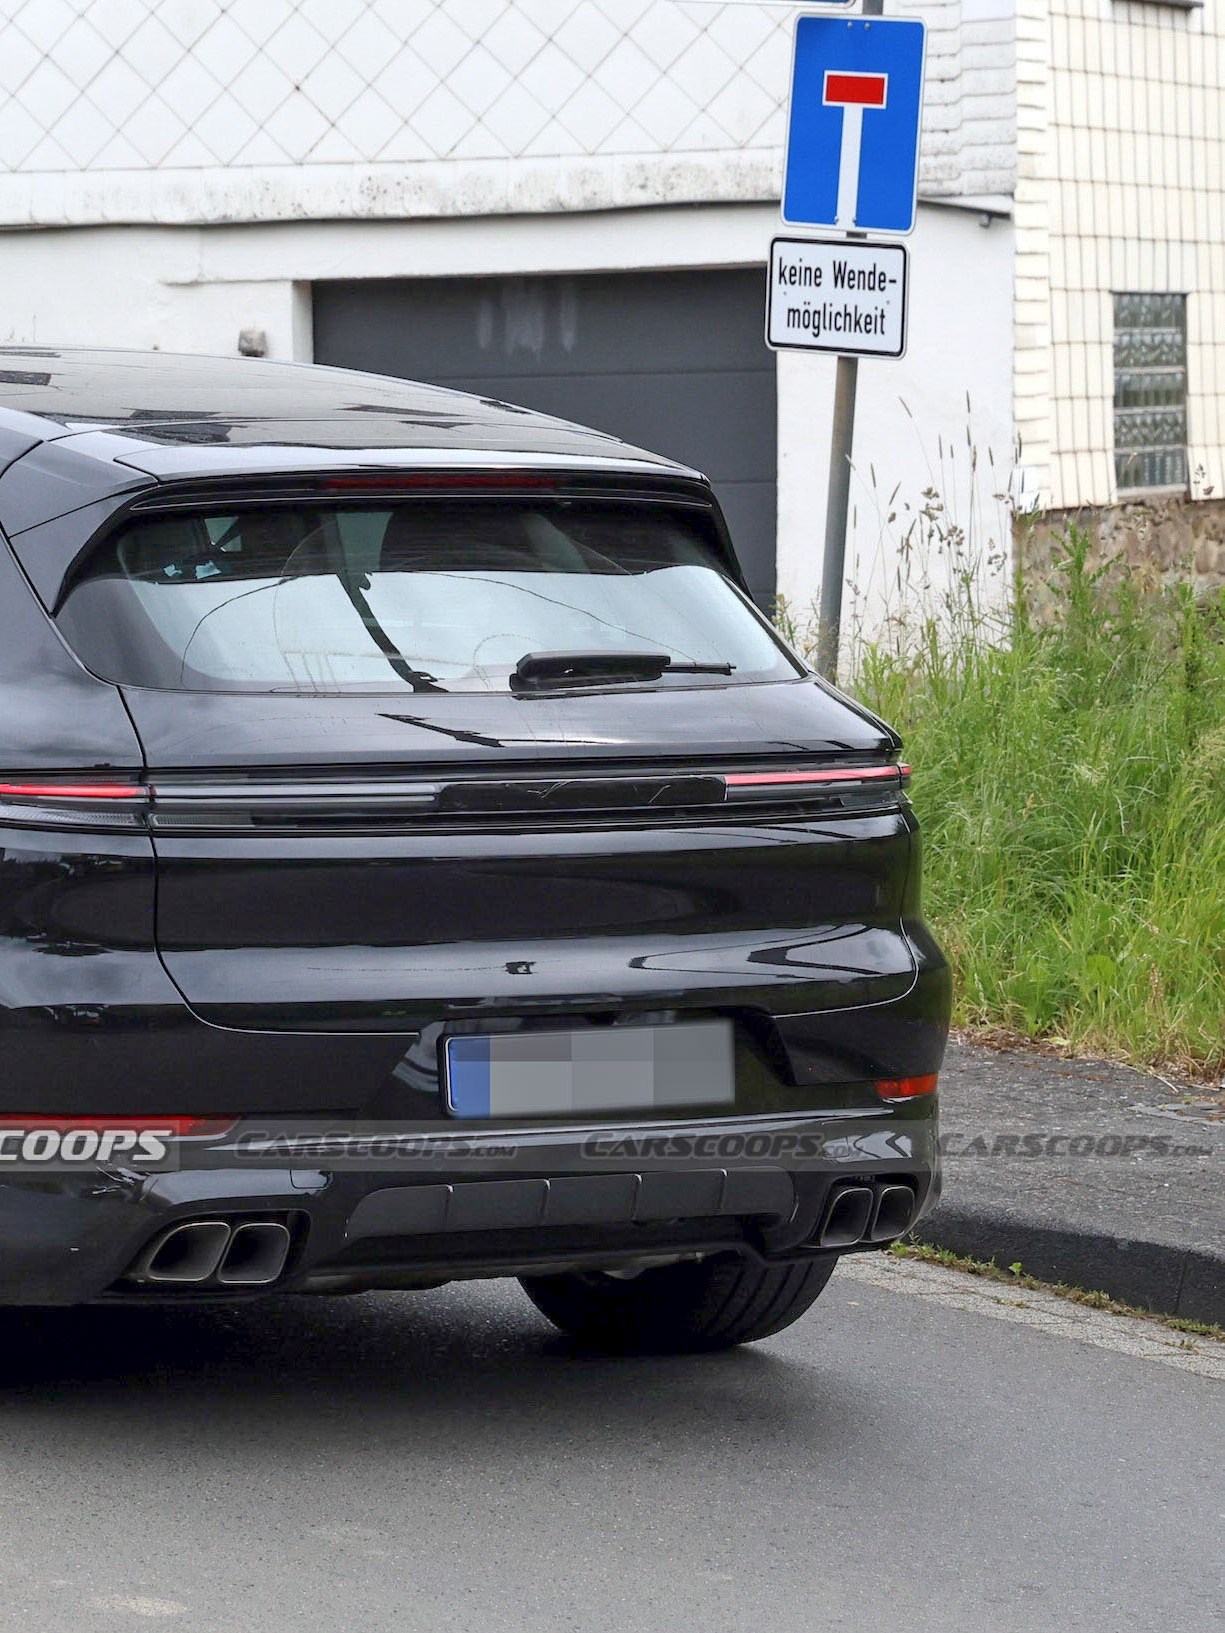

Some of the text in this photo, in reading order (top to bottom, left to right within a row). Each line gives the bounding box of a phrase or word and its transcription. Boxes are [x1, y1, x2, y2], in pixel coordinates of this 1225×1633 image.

[778, 256, 897, 292] keine Wende-
[786, 300, 886, 338] möglichkeit
